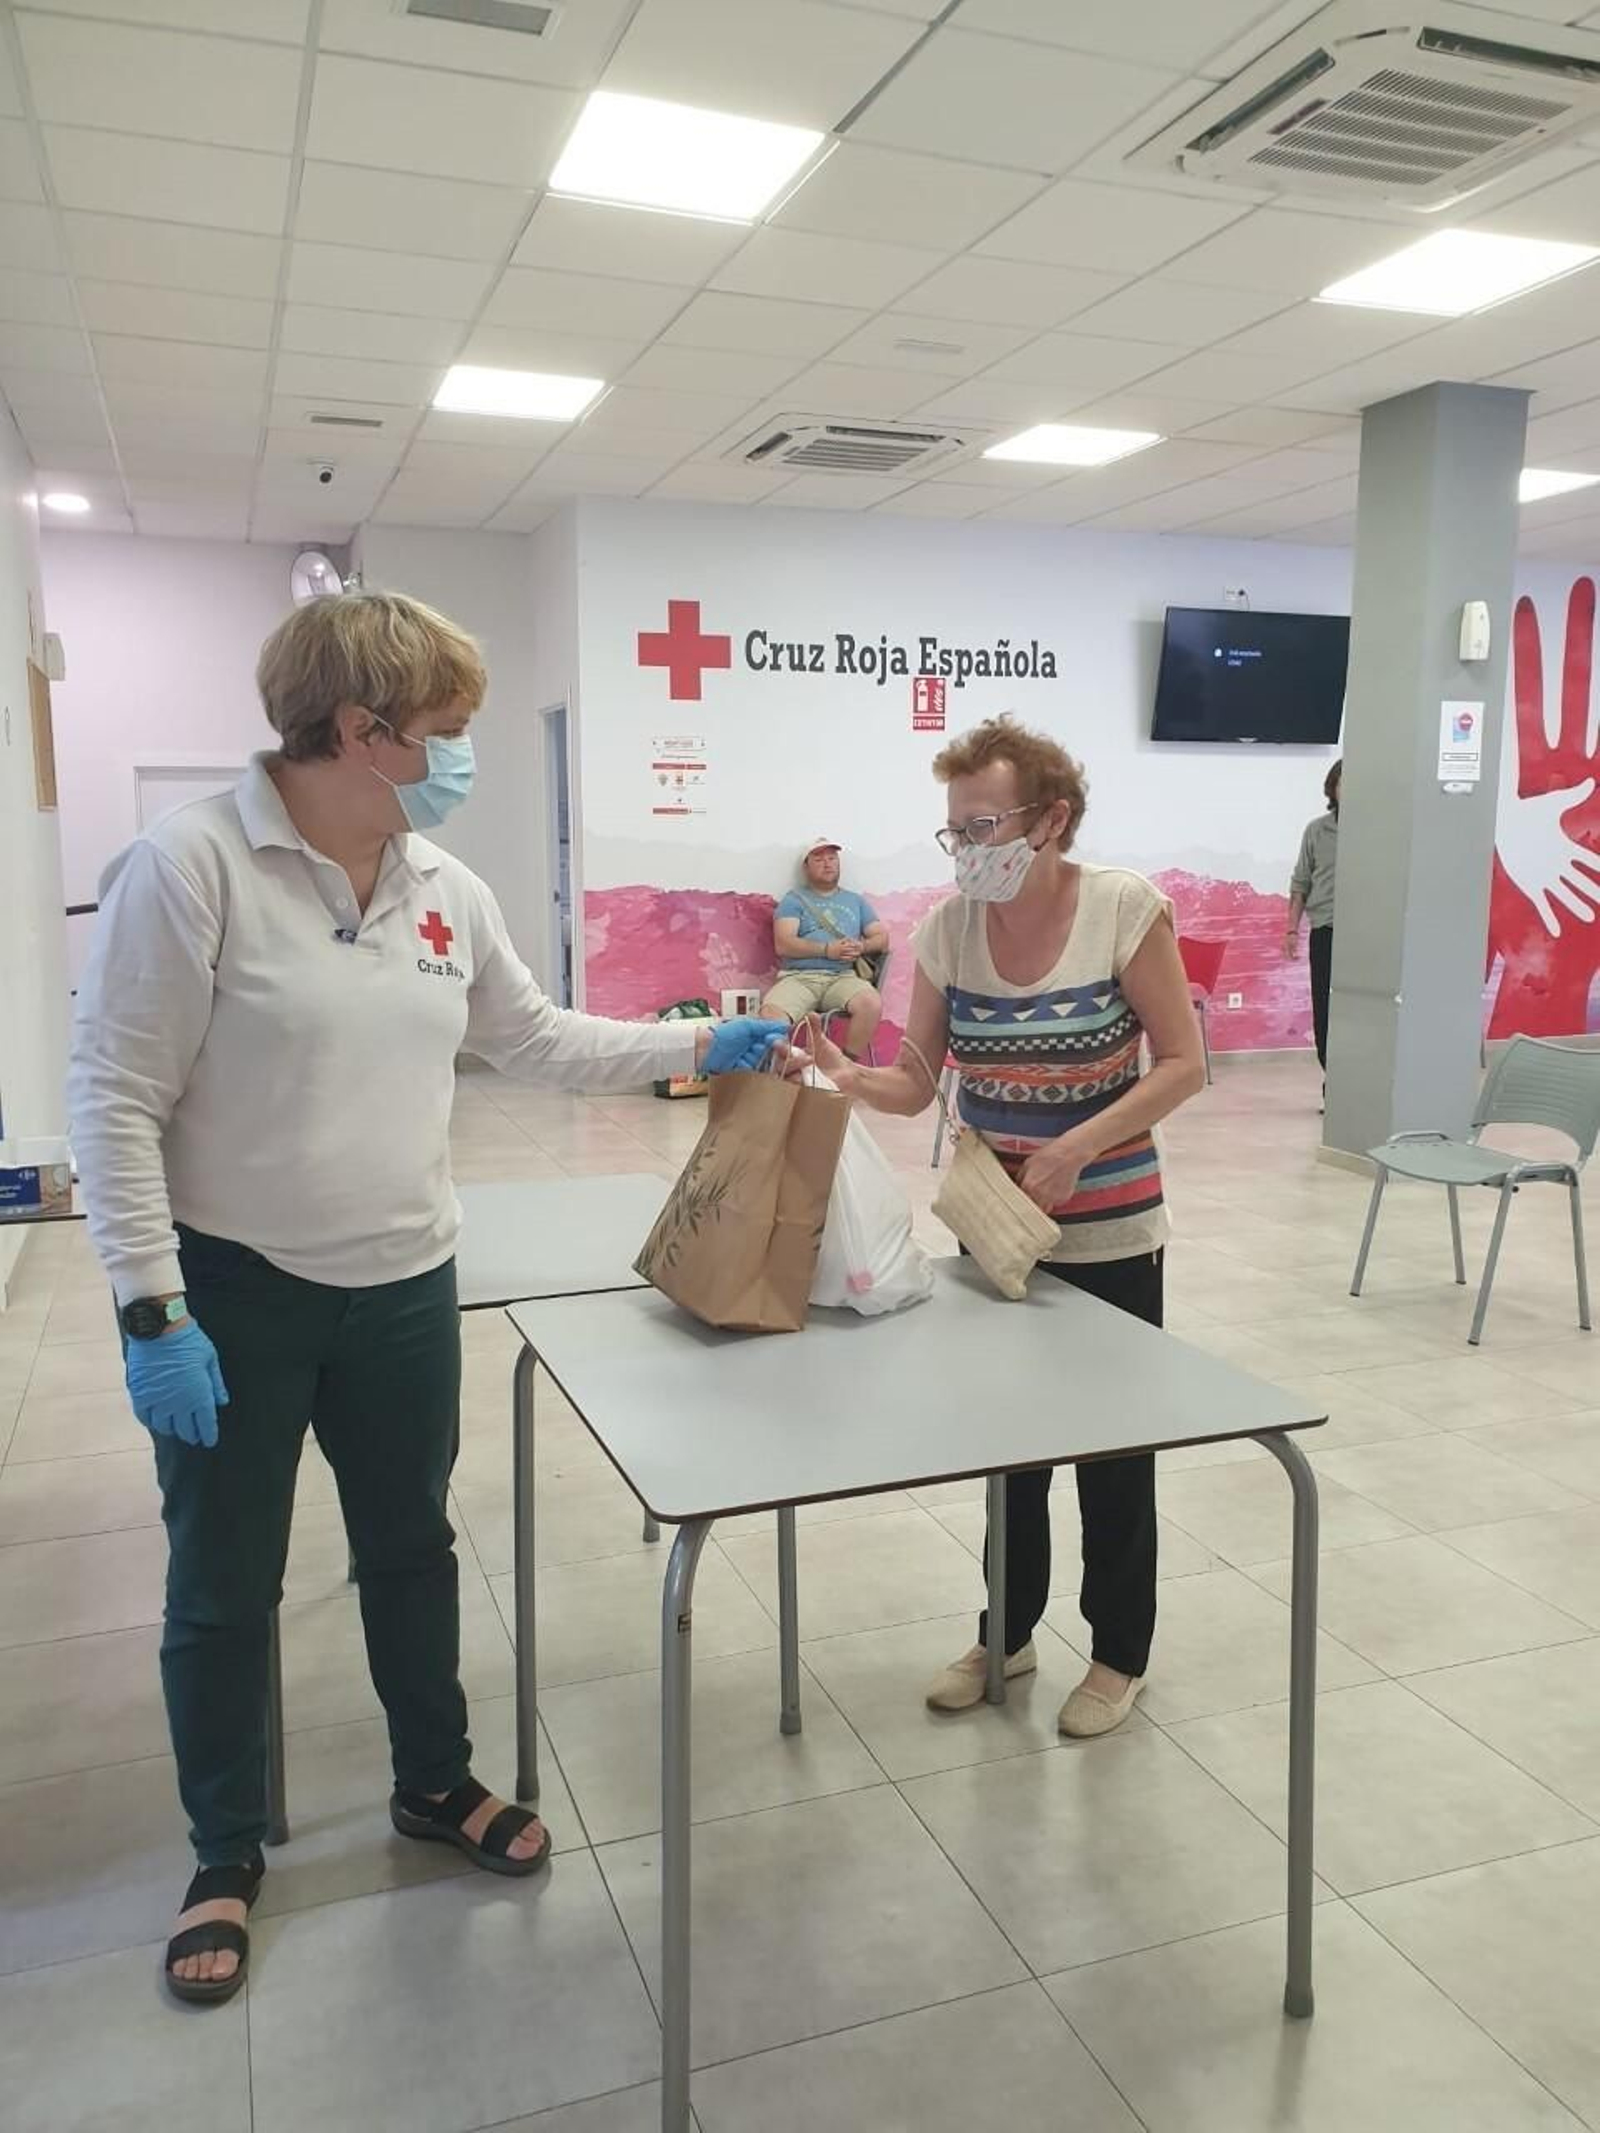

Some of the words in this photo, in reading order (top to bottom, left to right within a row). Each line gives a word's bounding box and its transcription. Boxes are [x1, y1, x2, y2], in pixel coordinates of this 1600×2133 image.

[745, 629, 825, 673] Cruz
[835, 634, 909, 686] Roja
[918, 637, 1057, 688] Española
[417, 958, 444, 976] Cruz
[445, 961, 466, 982] Ra
